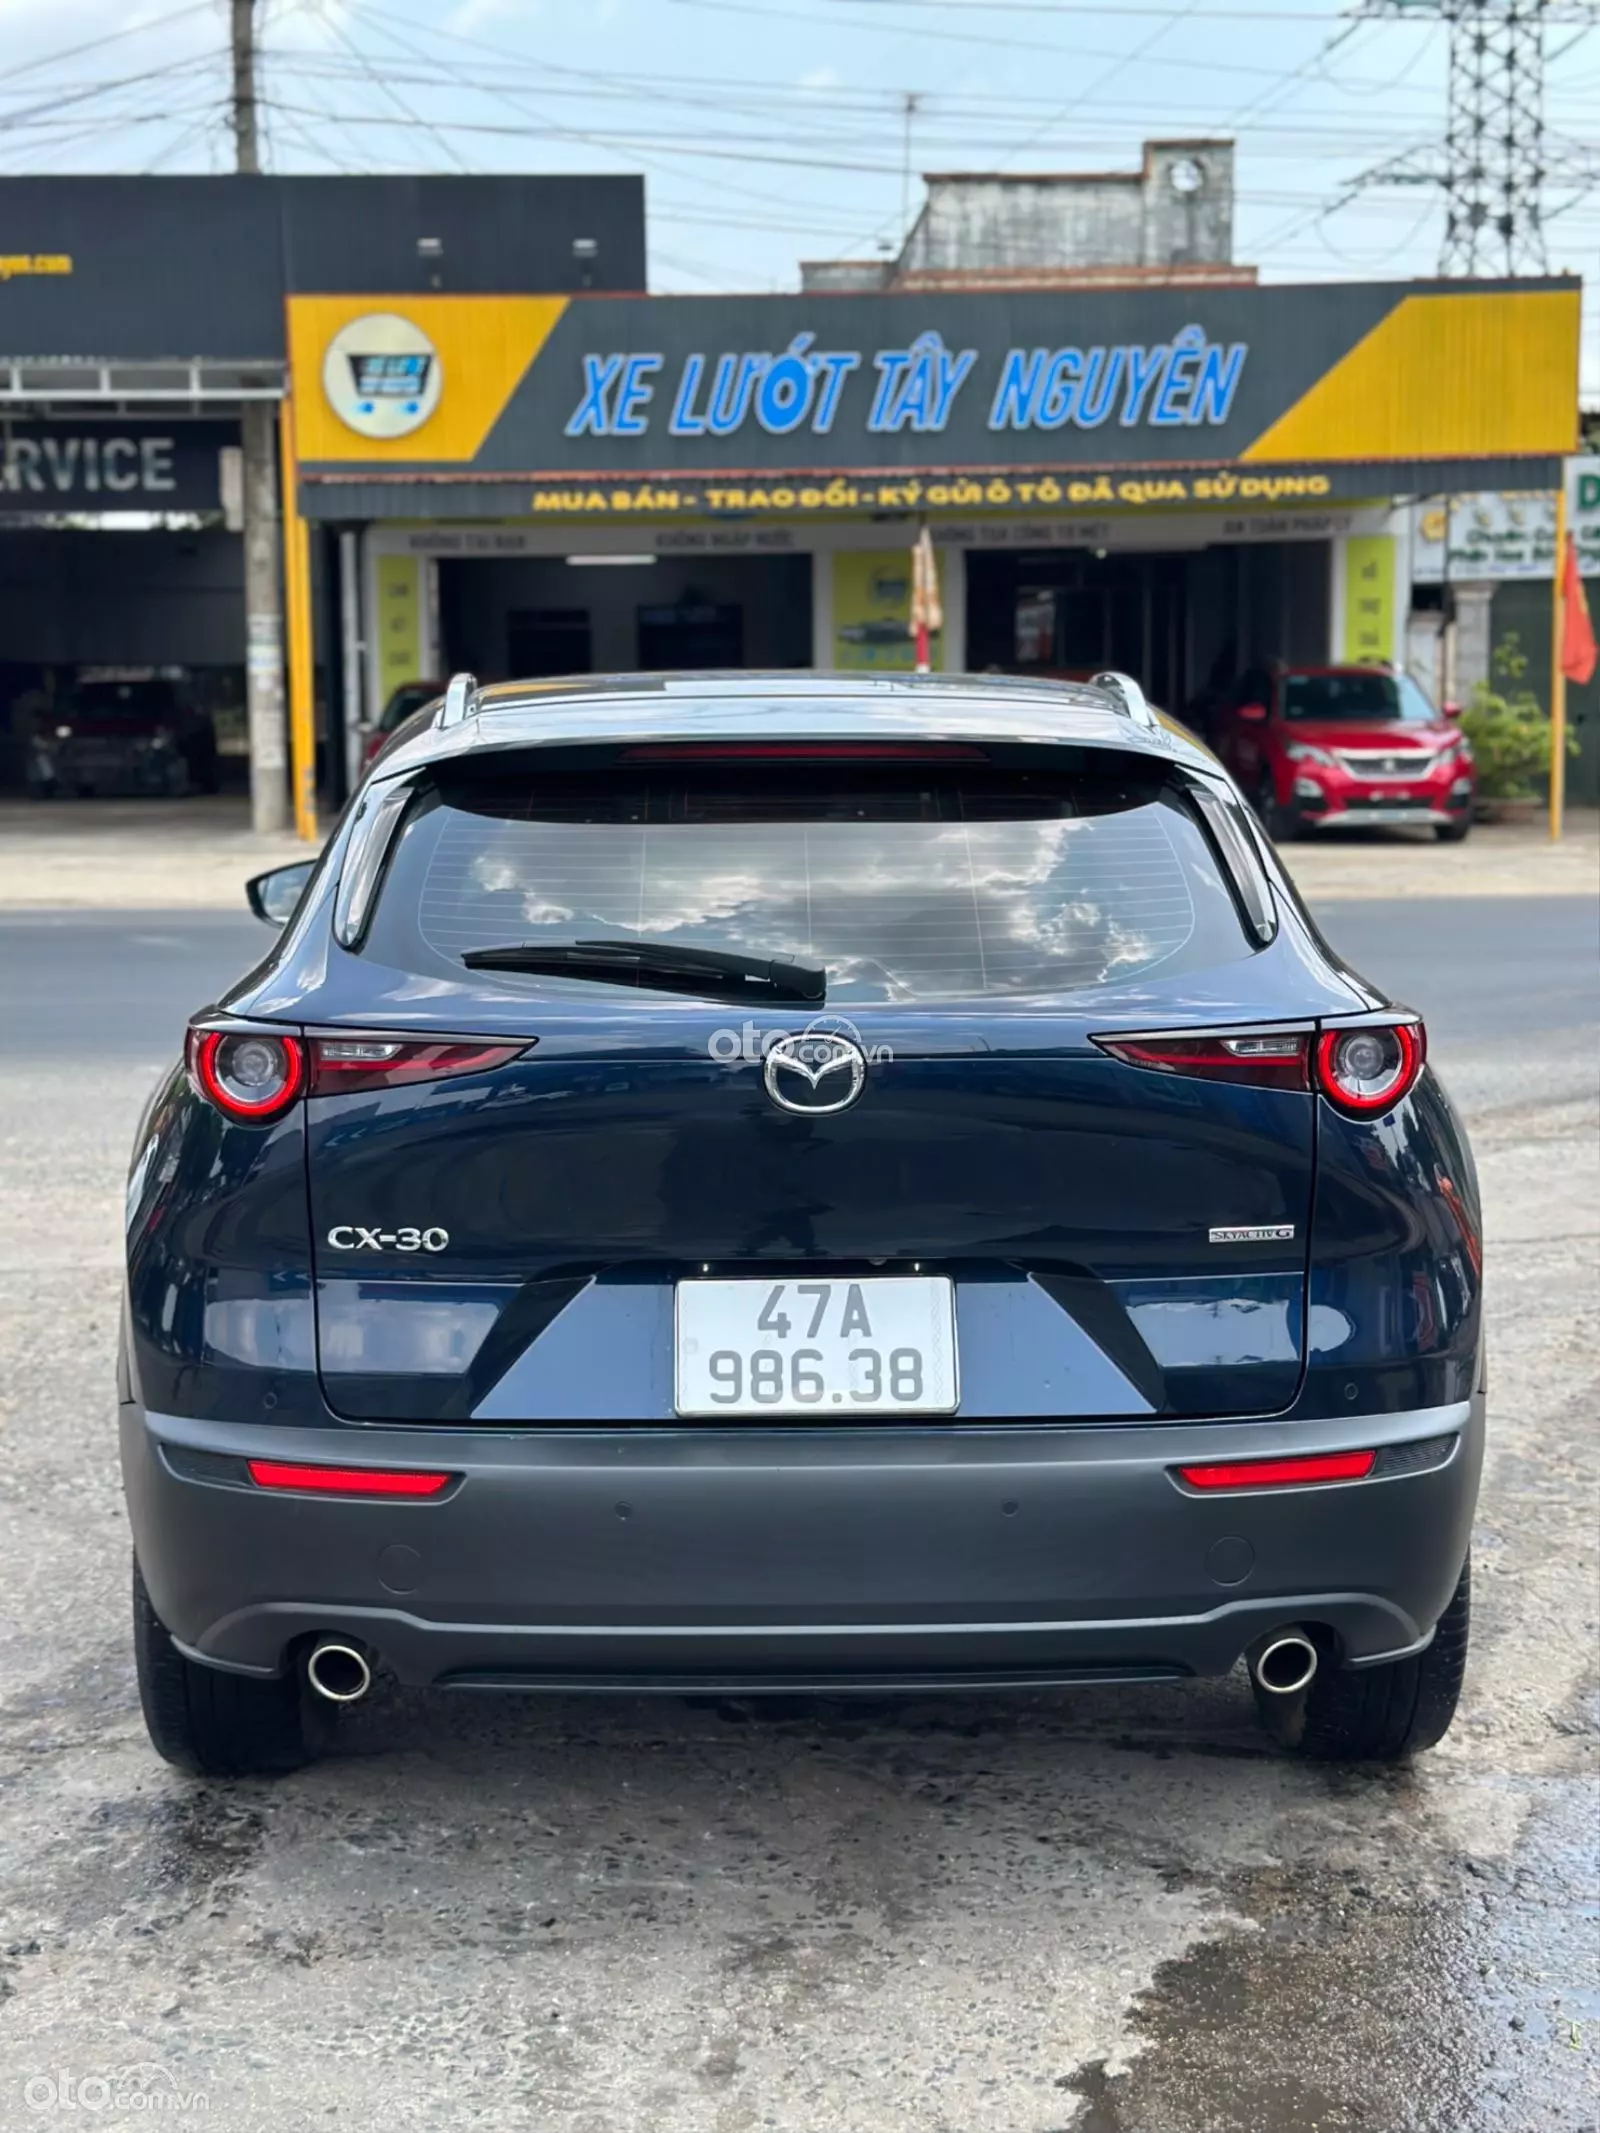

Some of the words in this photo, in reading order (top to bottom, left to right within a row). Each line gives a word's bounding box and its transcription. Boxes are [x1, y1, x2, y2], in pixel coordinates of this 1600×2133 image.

[564, 353, 663, 436] XE
[668, 331, 861, 436] LƯỚT
[867, 330, 978, 431] TÂY
[988, 323, 1248, 430] NGUYÊN
[0, 436, 176, 492] RVICE
[533, 489, 608, 510] MUA
[611, 484, 679, 510] BÁN
[705, 488, 796, 509] TRAO
[878, 478, 923, 505] KÝ
[1015, 476, 1061, 503] TÔ
[1067, 475, 1114, 502] ĐÃ
[1118, 479, 1186, 504] QUA
[1240, 474, 1331, 501] DỤNG
[327, 1226, 449, 1252] CX-30
[757, 1284, 872, 1338] 47A
[709, 1348, 923, 1404] 986.38
